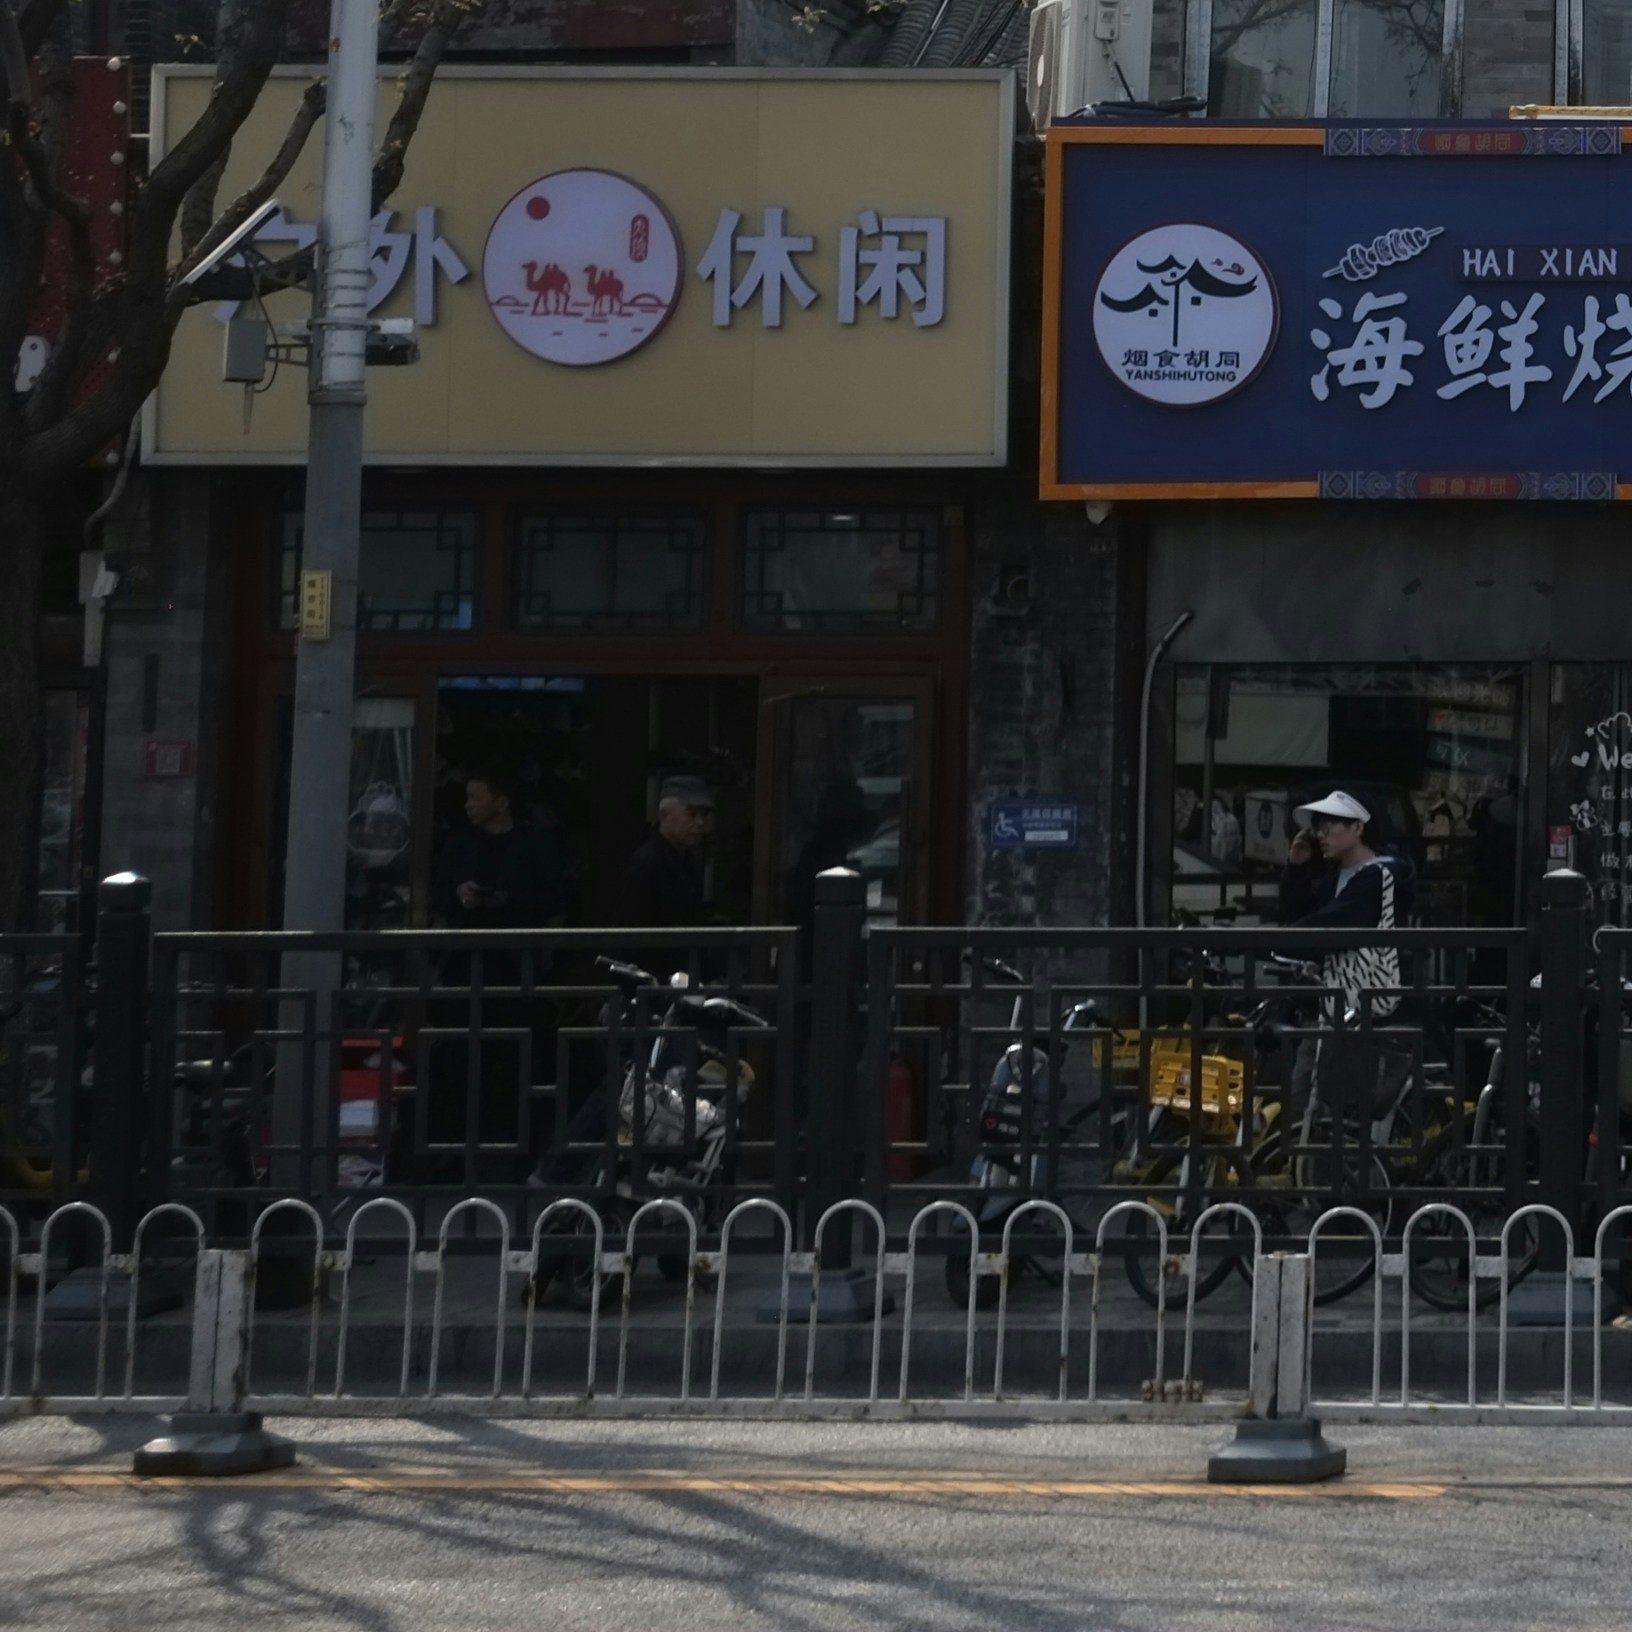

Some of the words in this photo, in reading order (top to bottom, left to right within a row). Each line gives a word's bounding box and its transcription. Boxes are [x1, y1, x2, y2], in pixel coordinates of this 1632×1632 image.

[696, 207, 947, 329] 休闲
[1462, 248, 1515, 278] HAI
[1540, 248, 1618, 278] XIAN
[1123, 347, 1241, 369] 烟食胡同
[1125, 369, 1237, 382] YANSHIHUTONG
